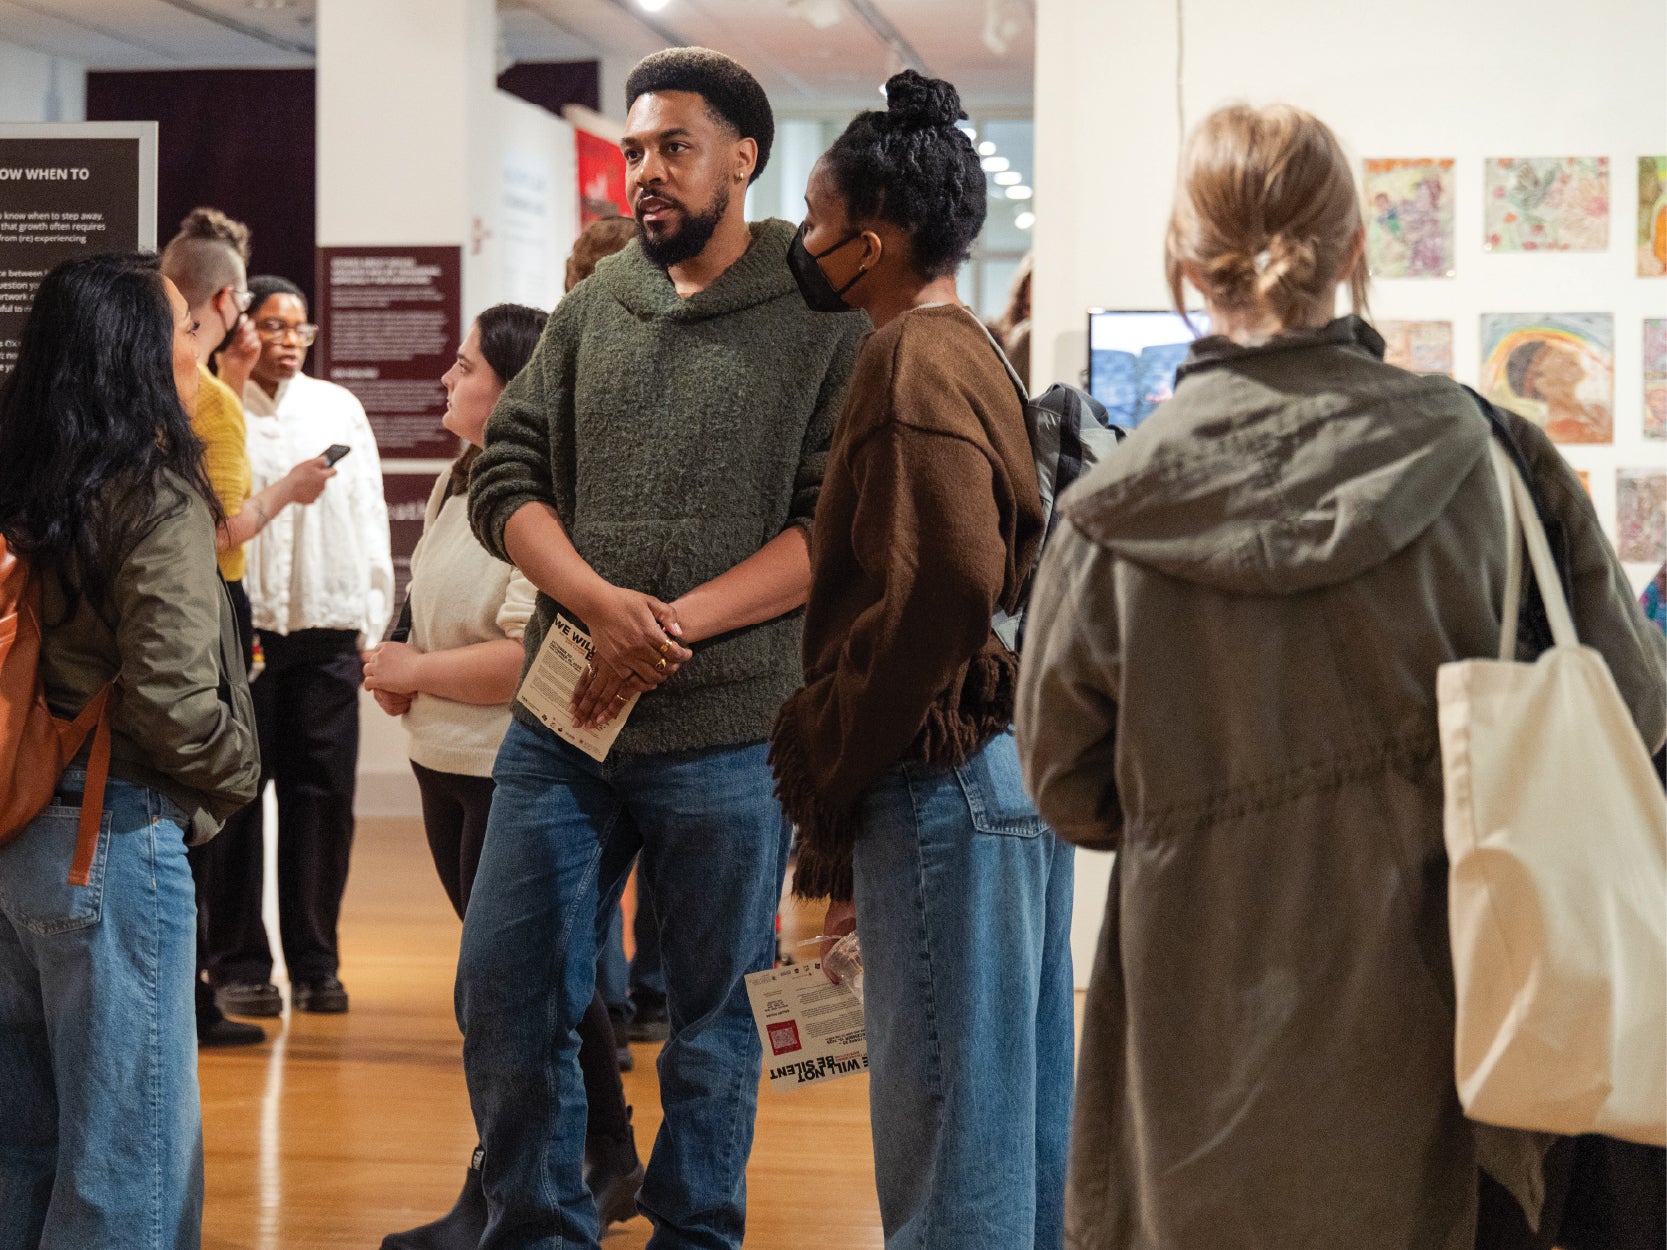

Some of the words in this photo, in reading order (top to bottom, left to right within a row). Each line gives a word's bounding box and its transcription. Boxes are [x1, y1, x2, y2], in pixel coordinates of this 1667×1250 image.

[25, 168, 68, 180] WHEN
[70, 168, 90, 180] TO
[4, 211, 26, 220] know
[27, 211, 50, 220] when
[51, 212, 60, 220] to
[61, 213, 79, 221] step
[1, 222, 17, 231] that
[18, 222, 48, 233] growth
[49, 222, 71, 231] often
[71, 223, 106, 232] requires
[34, 235, 87, 244] experiencing
[8, 269, 43, 277] between
[554, 618, 571, 636] WE
[572, 631, 596, 654] WILL
[817, 1056, 834, 1069] BE
[829, 1058, 860, 1074] WILL
[862, 1056, 868, 1067] E
[770, 1060, 815, 1080] SILENT
[798, 1066, 825, 1083] NOT
